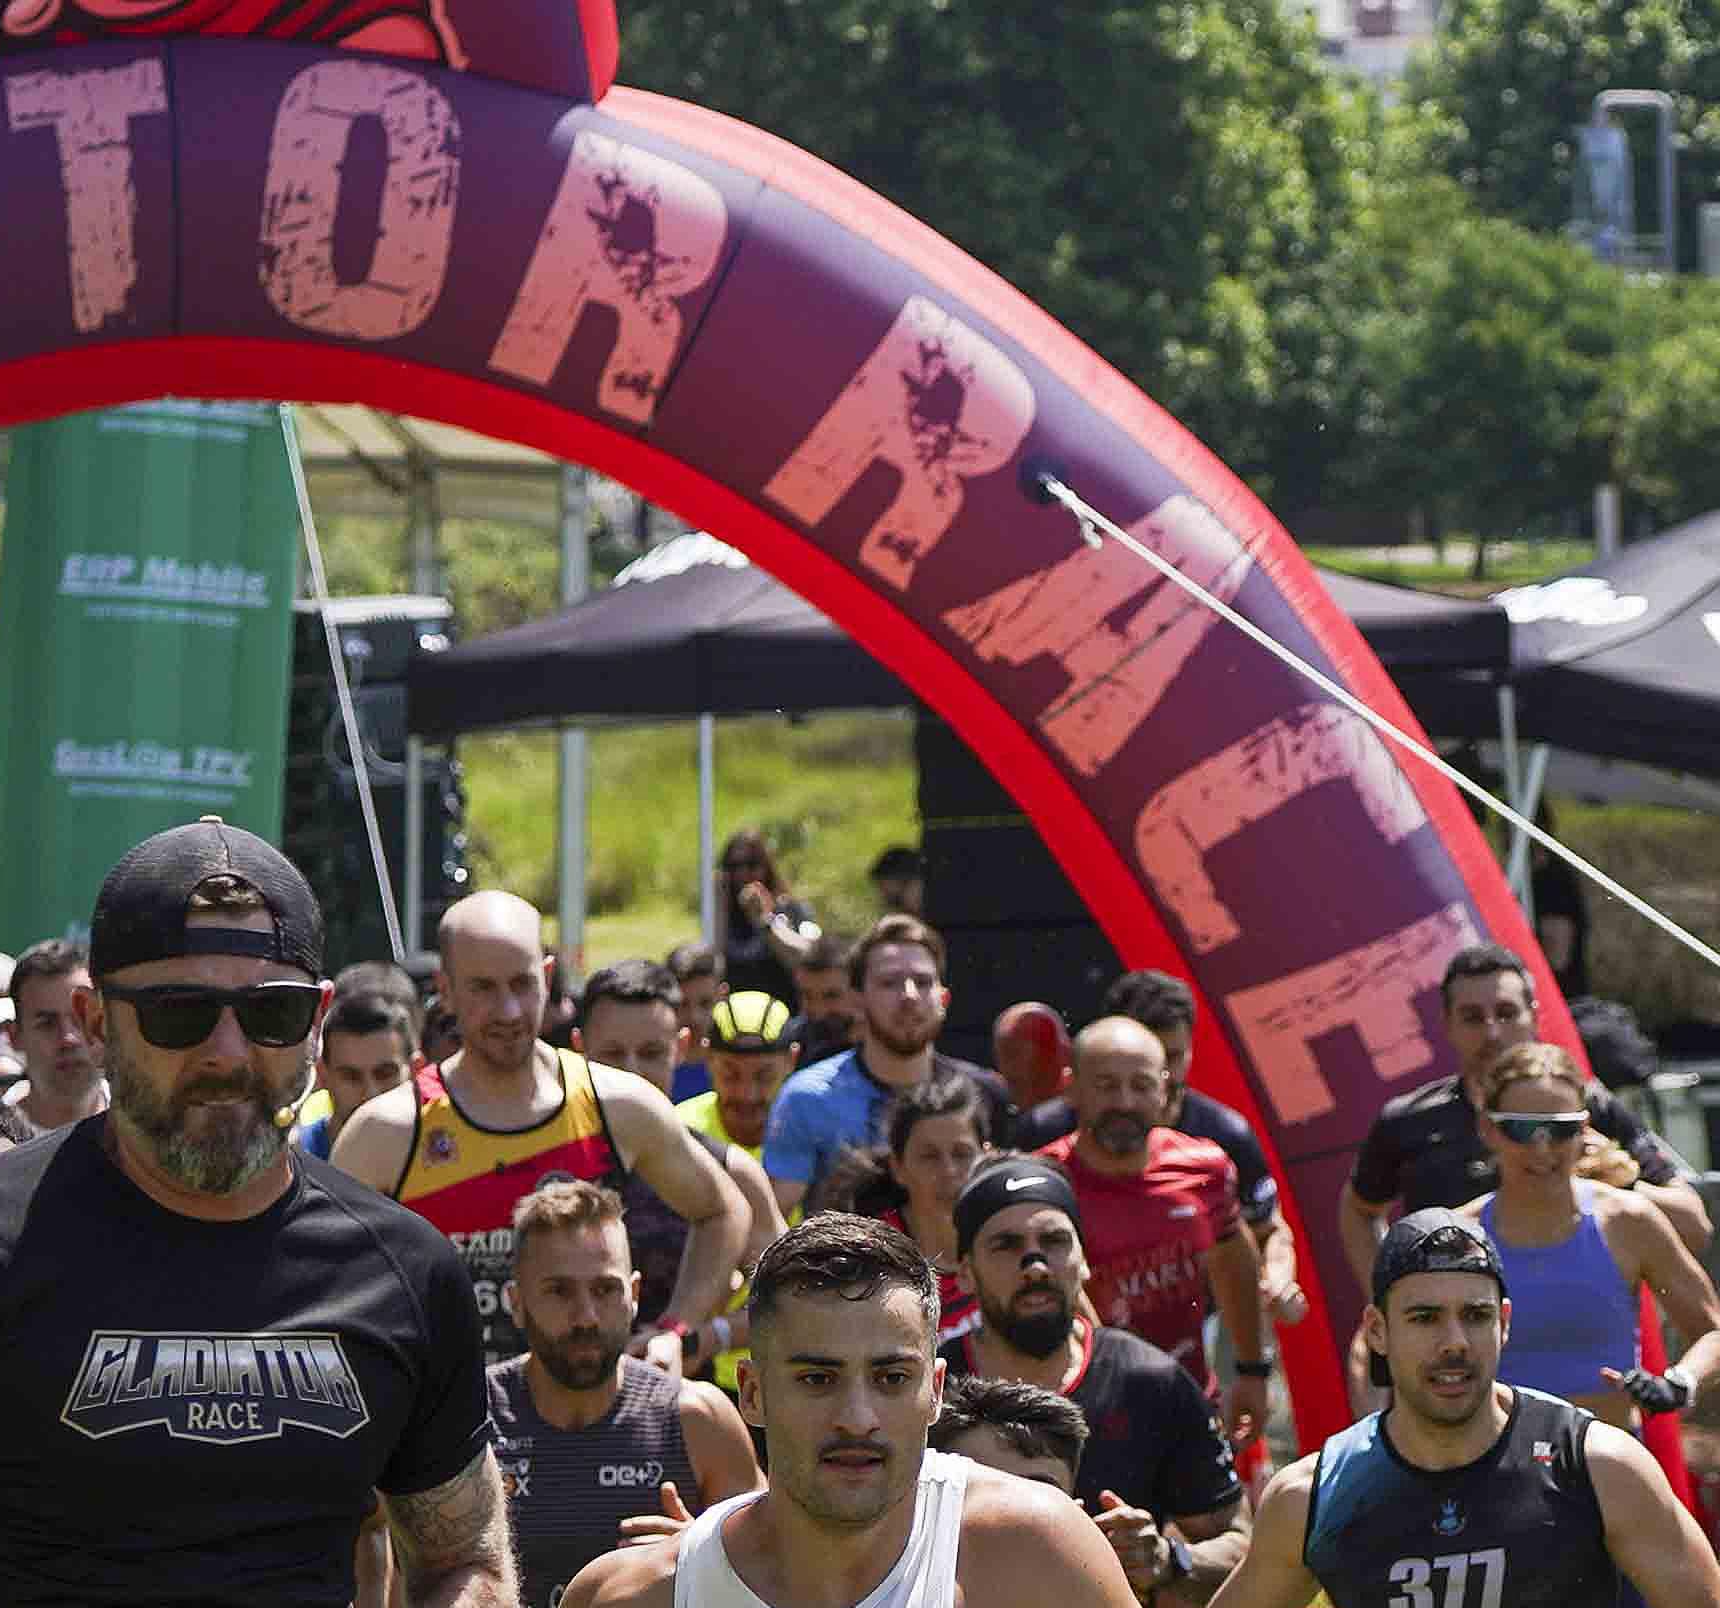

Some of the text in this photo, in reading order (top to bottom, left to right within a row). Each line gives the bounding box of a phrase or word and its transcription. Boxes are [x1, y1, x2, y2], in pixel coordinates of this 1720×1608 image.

[763, 296, 1479, 1127] RACE
[71, 1337, 362, 1413] GLADIATOR
[186, 1402, 263, 1431] RACE
